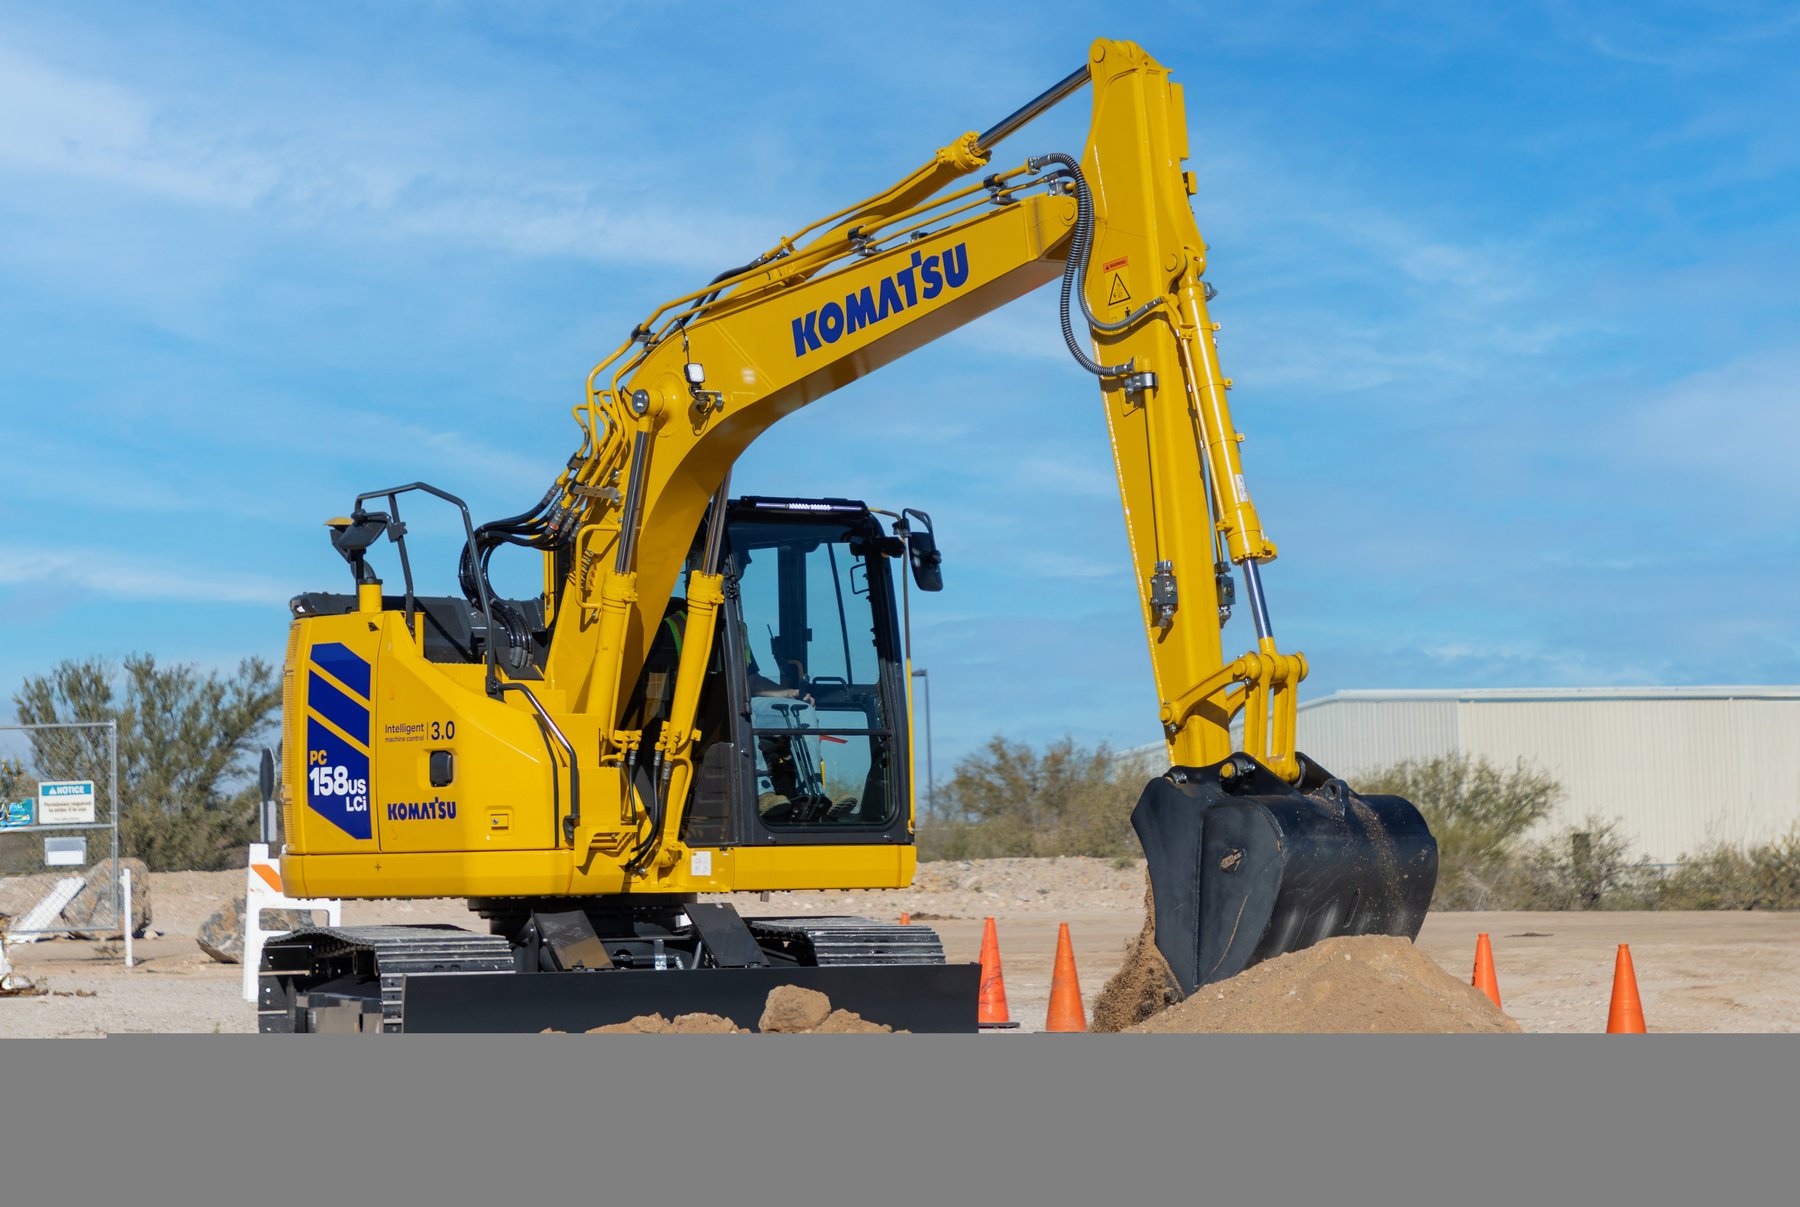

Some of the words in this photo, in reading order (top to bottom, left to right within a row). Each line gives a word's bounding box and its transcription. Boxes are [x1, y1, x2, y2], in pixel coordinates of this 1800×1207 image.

[791, 242, 969, 358] KOMATSU
[385, 723, 424, 735] Intelligent
[431, 720, 455, 740] 3.0
[309, 750, 327, 765] PC
[57, 785, 85, 795] NOTICE
[345, 795, 367, 812] LCi
[387, 797, 456, 820] KOMATSU
